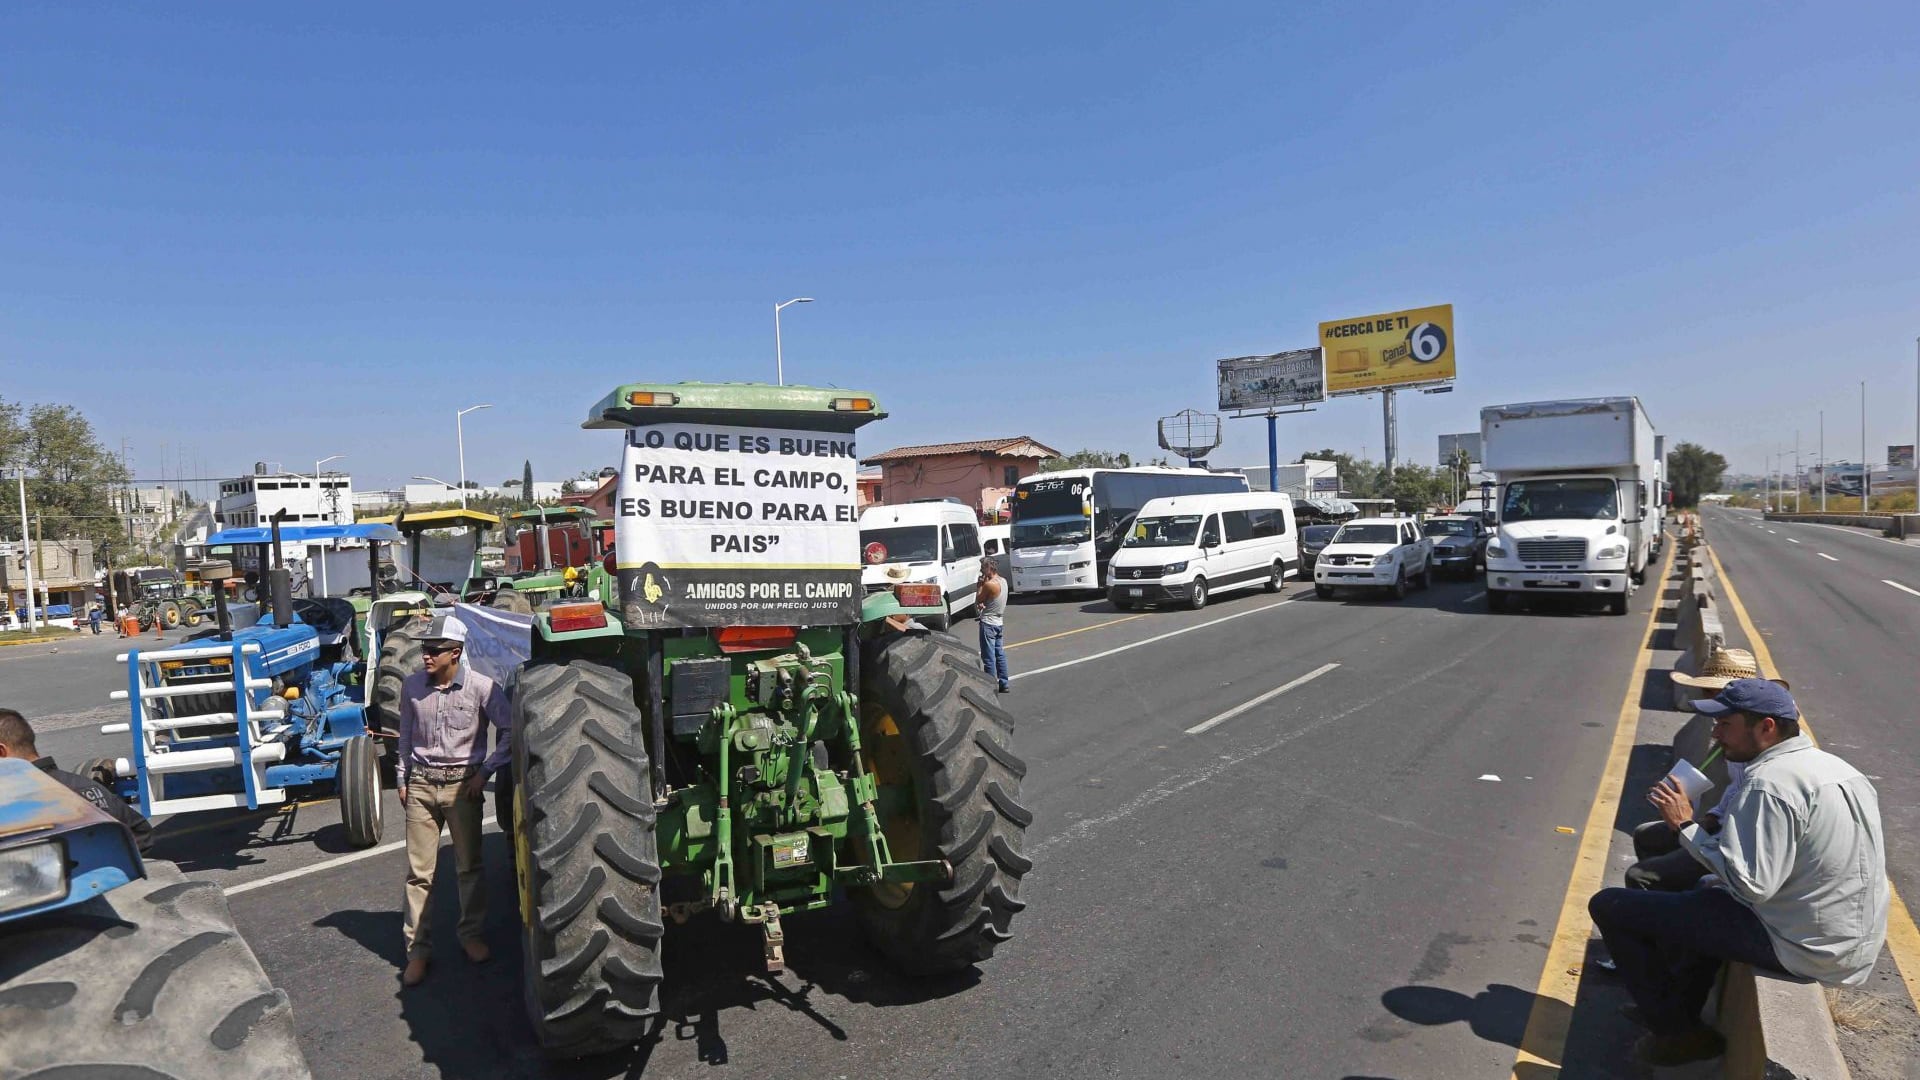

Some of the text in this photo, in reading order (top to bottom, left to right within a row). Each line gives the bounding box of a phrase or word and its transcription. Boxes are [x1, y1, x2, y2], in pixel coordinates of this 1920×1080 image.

[1326, 316, 1409, 339] #CERCA DE TI
[1382, 322, 1440, 362] Canal 6
[674, 432, 730, 452] QUE
[739, 435, 771, 454] ES
[635, 464, 849, 494] PARA EL CAMPO,
[1071, 483, 1082, 495] 06
[620, 498, 858, 523] ES BUENO PARA EL
[685, 582, 853, 599] AMIGOS POR EL CAMPO
[704, 602, 738, 610] UNIDOS
[740, 602, 759, 610] POR
[762, 602, 774, 610] UN
[811, 601, 839, 609] JUSTO
